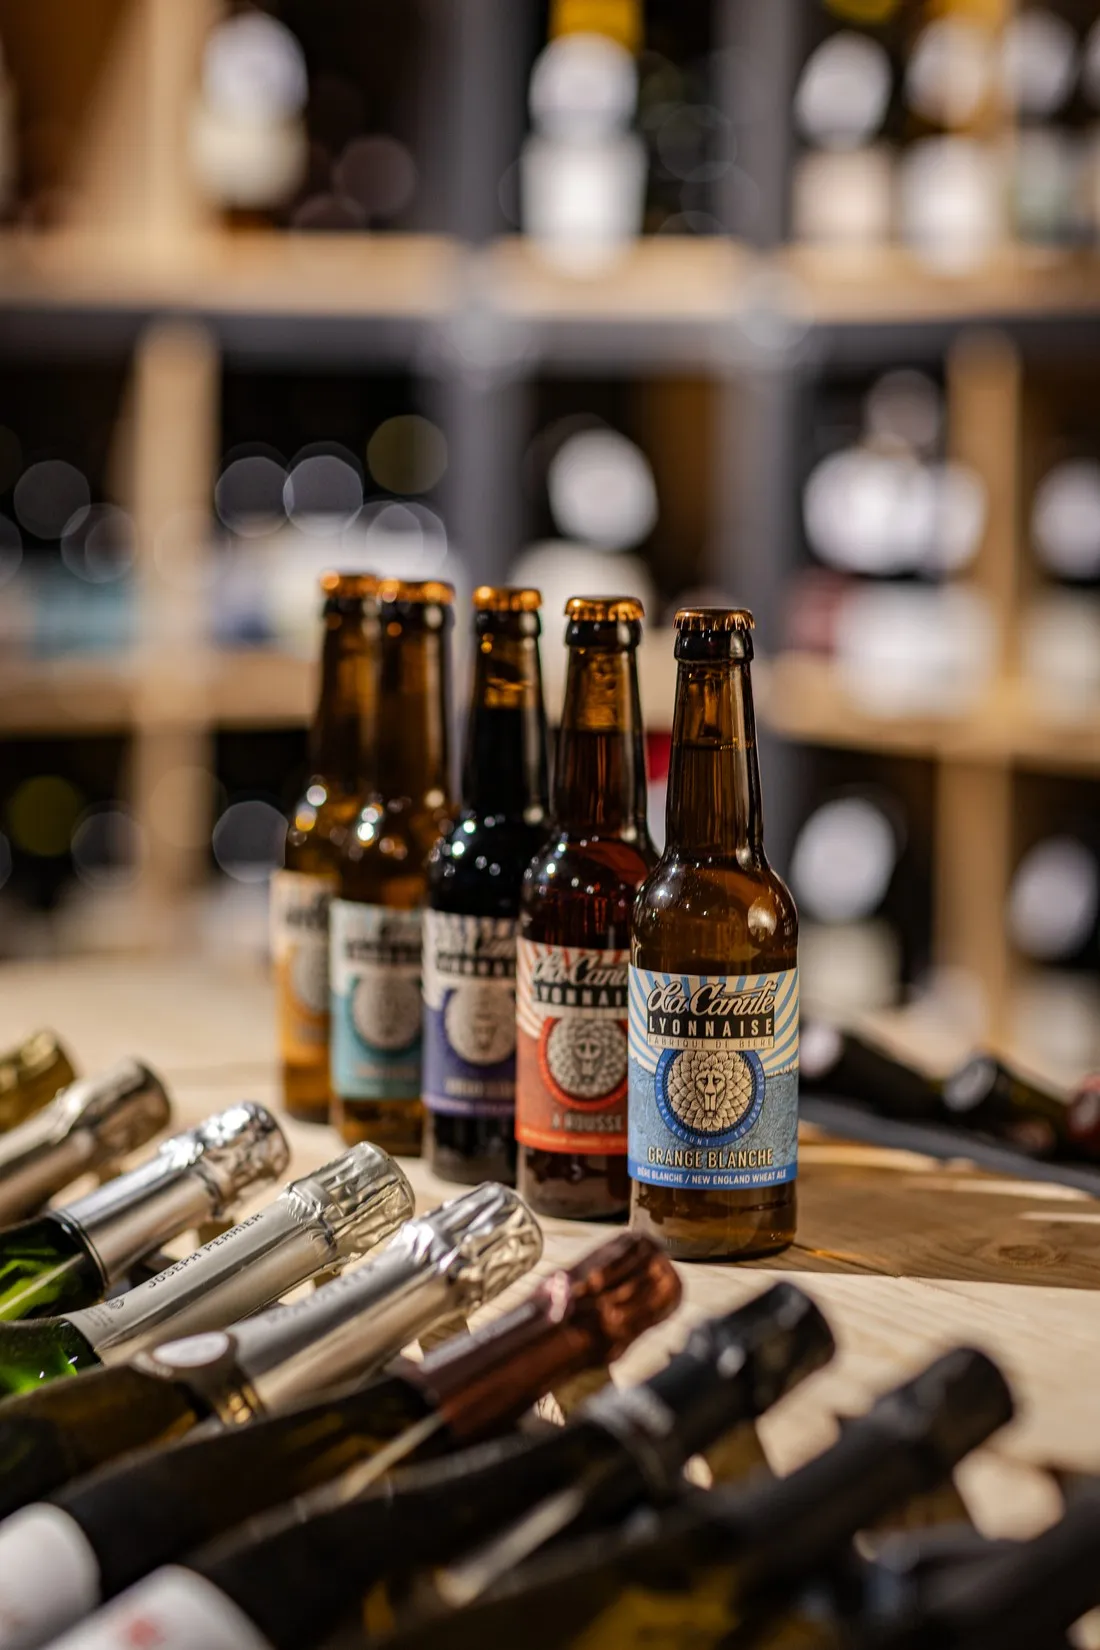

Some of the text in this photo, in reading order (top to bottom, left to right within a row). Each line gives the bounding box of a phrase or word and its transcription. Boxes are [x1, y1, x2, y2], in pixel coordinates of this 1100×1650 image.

[648, 981, 688, 1014] La
[689, 981, 778, 1016] Canute
[648, 1015, 773, 1038] LYONNAISE
[648, 1035, 705, 1049] FABRIQUE
[715, 1039, 728, 1049] DE
[647, 1146, 774, 1169] GRANGE BLANCHE
[651, 1169, 683, 1184] BLANCHE
[684, 1173, 690, 1184] /
[691, 1174, 711, 1185] NEW
[712, 1174, 750, 1185] ENGLAND
[751, 1171, 775, 1183] WHEAT
[776, 1168, 787, 1180] ALE
[148, 1212, 265, 1289] JOSEPH PERRIER
